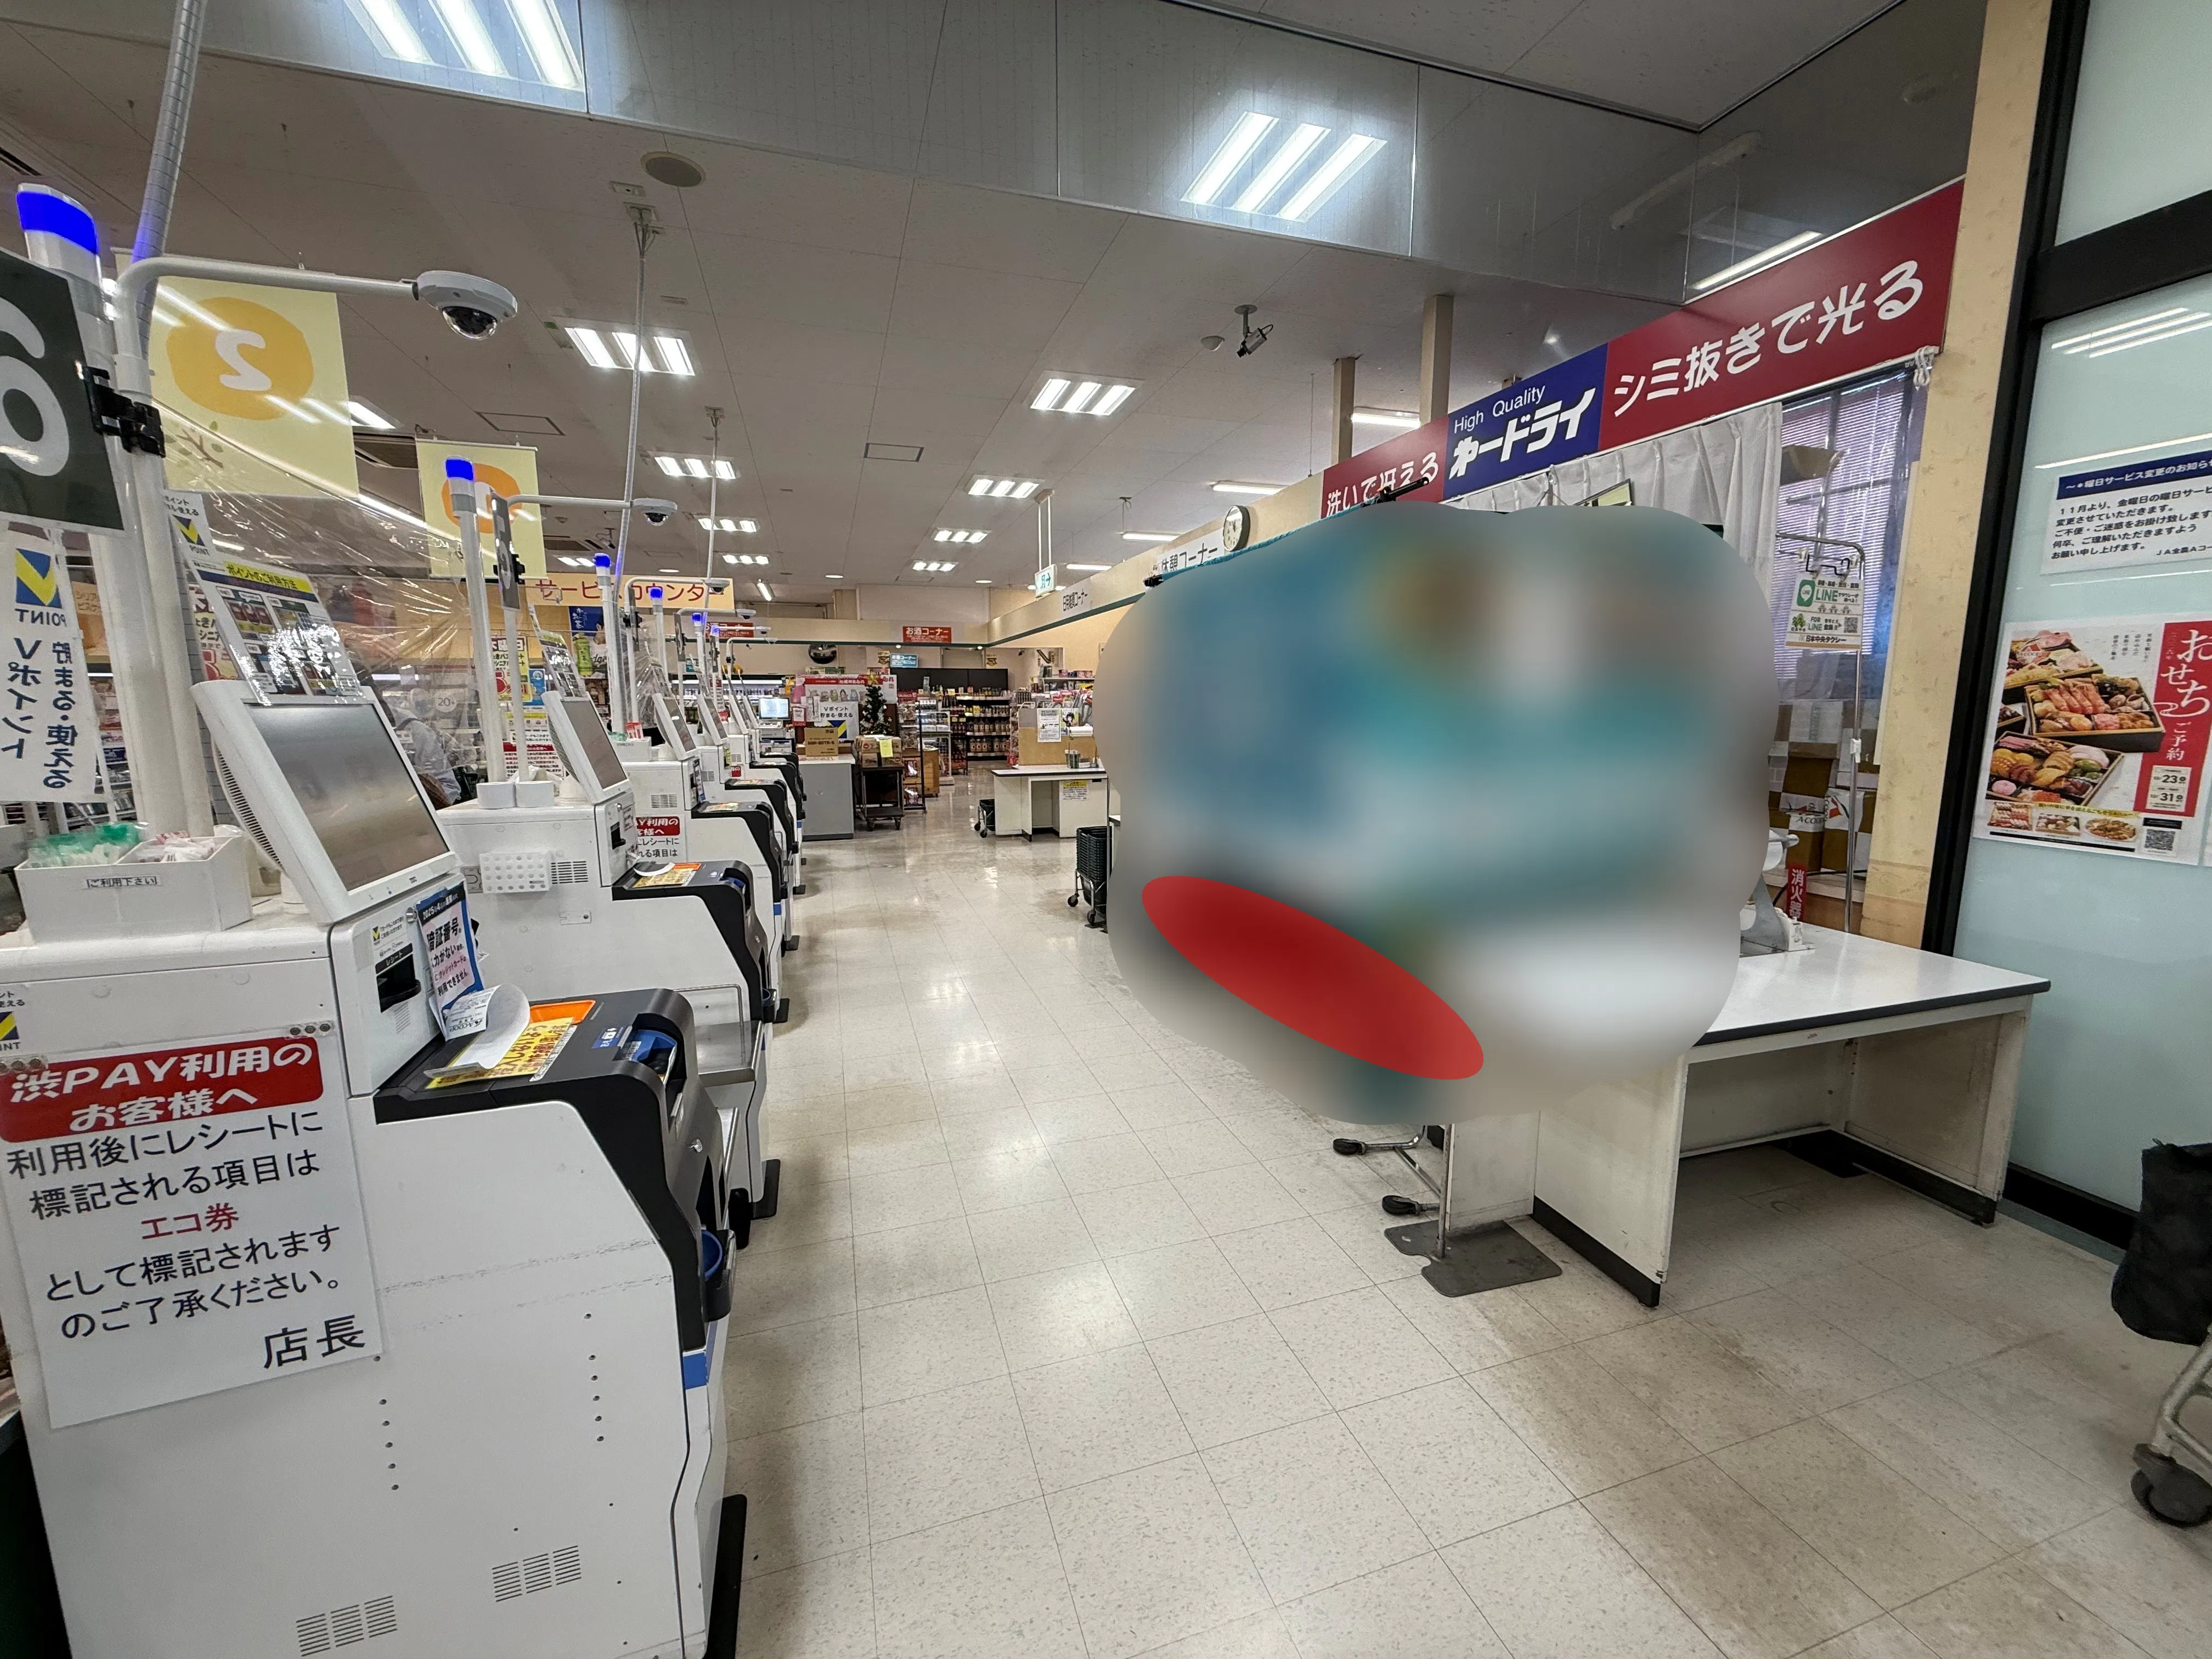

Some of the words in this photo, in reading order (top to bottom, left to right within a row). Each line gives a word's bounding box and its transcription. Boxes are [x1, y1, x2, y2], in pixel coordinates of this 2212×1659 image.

[1614, 261, 1922, 417] シミ抜きで光る
[0, 294, 70, 476] 6
[1454, 410, 1484, 434] High
[1492, 385, 1546, 418] Quality
[1816, 589, 1838, 602] LINE
[906, 627, 949, 635] お酒コーナー
[2165, 721, 2192, 760] ご予約
[91, 878, 154, 887] ご利用下さい
[1790, 869, 1805, 919] 消火器
[386, 951, 404, 966] レシート
[11, 1043, 312, 1103] 渋PAY利用の
[69, 1088, 257, 1132] お客様へ
[7, 1111, 323, 1180] 利用後にレシートに
[30, 1149, 320, 1221] 標記される項目は
[141, 1203, 239, 1240] エコ券
[46, 1224, 340, 1301] として標記されます
[61, 1268, 340, 1339] のご了承ください。
[263, 1315, 365, 1368] 店長
